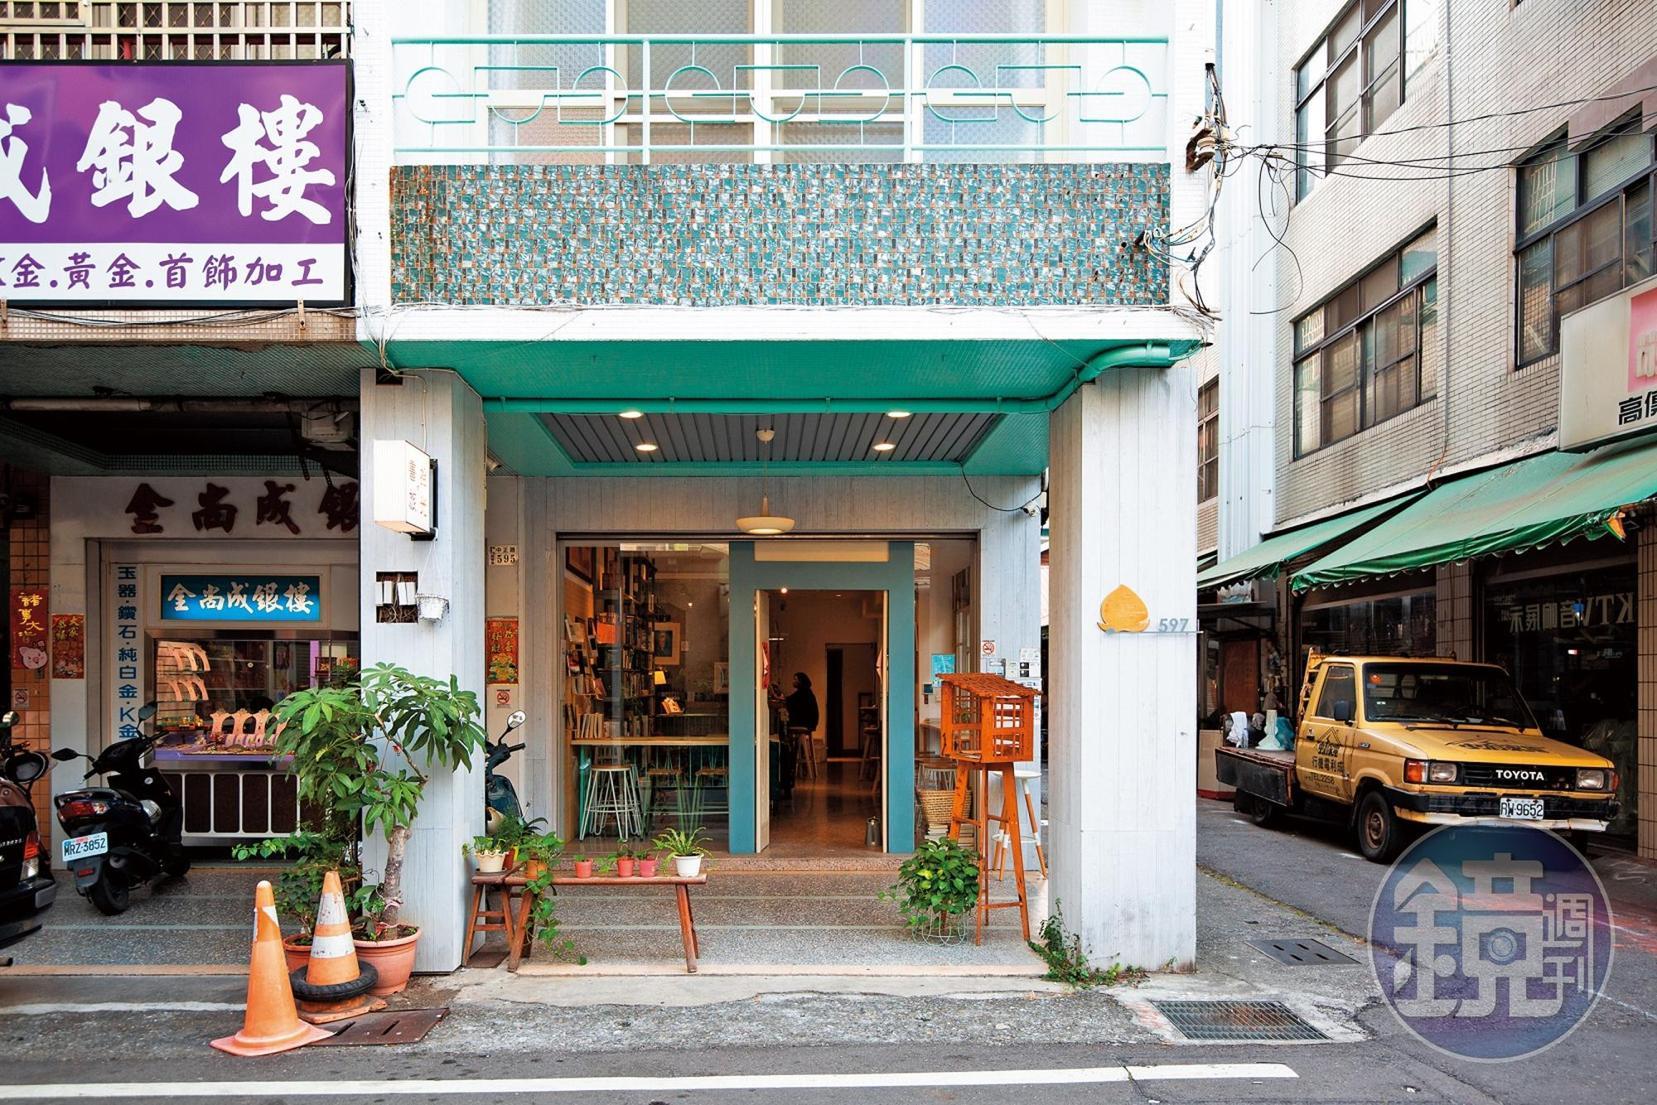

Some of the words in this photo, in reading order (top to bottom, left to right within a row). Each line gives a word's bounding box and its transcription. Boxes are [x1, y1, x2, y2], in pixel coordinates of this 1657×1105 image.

[0, 252, 323, 291] 金.黃金.首飾加工
[497, 554, 516, 564] 595
[1158, 618, 1189, 632] 597
[1495, 769, 1545, 781] TOYOTA
